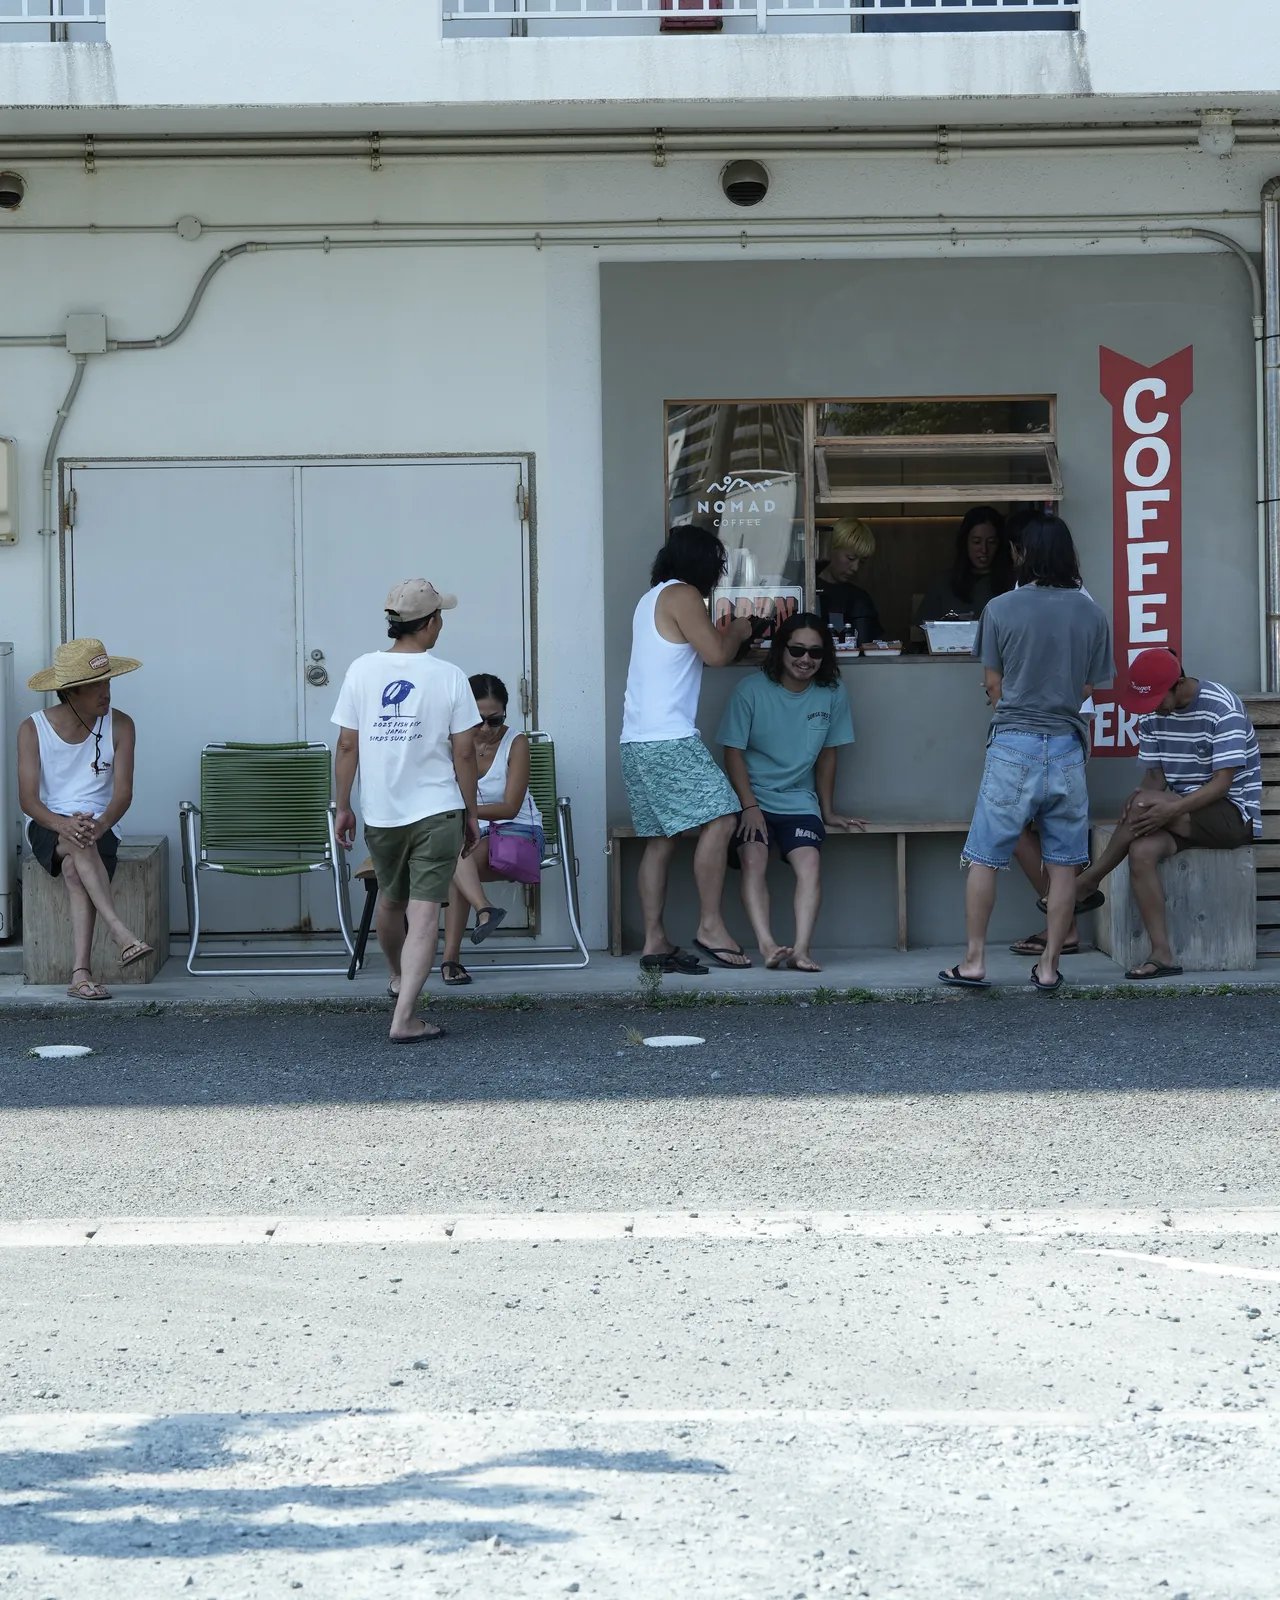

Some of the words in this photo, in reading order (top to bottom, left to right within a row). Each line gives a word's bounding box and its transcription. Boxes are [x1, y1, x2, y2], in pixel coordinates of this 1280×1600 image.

[697, 500, 776, 514] NOMAD
[713, 518, 761, 528] COFFEE
[1123, 377, 1171, 668] COFFE
[1093, 702, 1140, 747] ER
